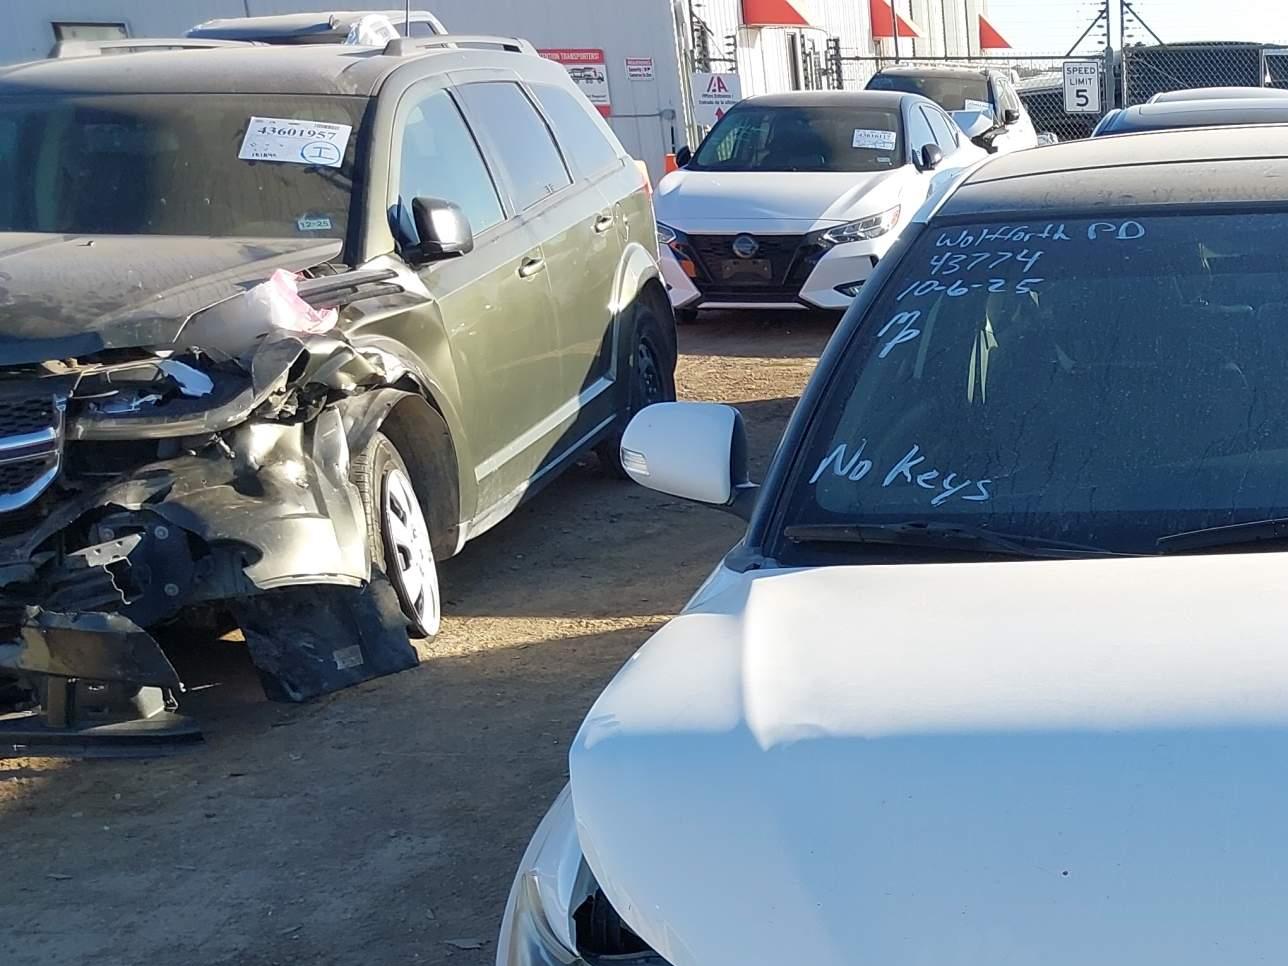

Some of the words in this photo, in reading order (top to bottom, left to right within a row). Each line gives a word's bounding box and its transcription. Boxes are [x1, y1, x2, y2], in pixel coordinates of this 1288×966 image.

[1066, 66, 1096, 75] SPEED
[1069, 77, 1094, 86] LIMIT
[1075, 88, 1089, 107] 5
[258, 126, 337, 140] 43601957
[1087, 220, 1146, 240] PD
[930, 250, 1043, 275] 43774
[809, 439, 874, 484] No
[882, 444, 993, 505] Keys
